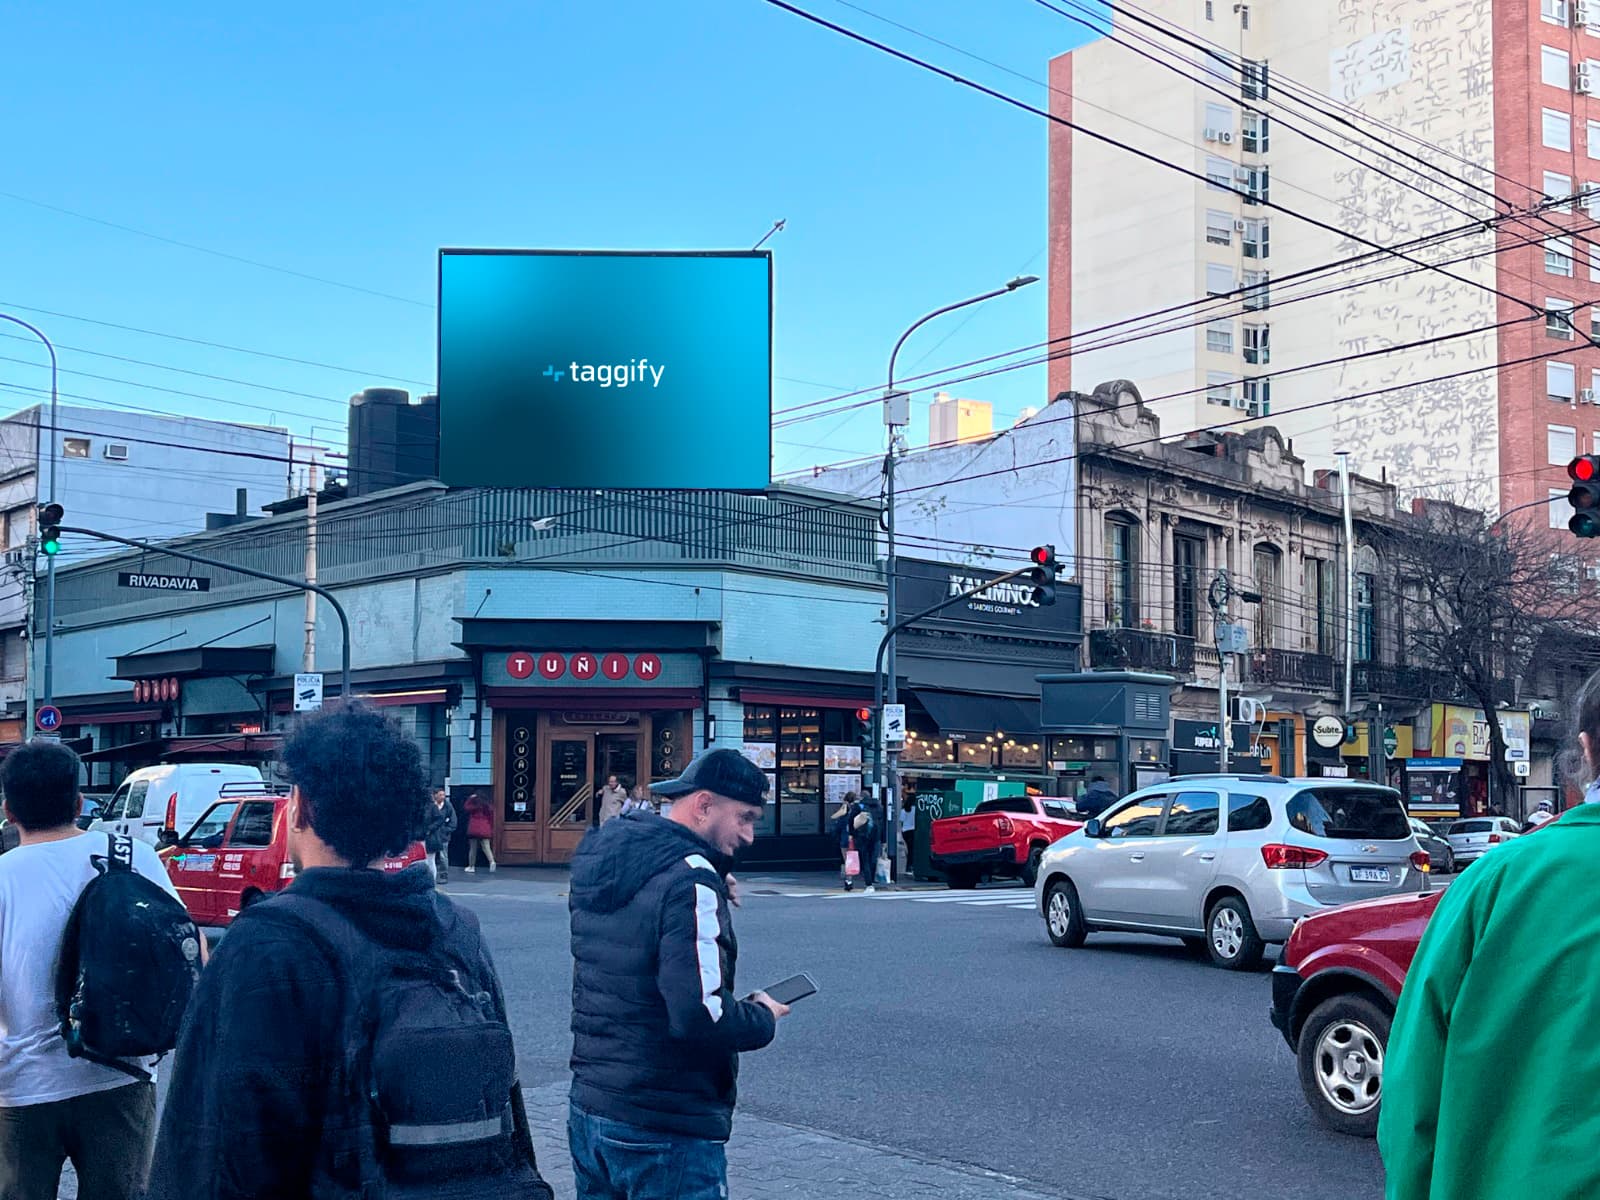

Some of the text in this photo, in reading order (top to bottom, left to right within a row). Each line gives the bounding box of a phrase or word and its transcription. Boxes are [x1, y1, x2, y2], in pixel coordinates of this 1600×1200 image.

[569, 358, 665, 388] taggify
[128, 575, 199, 590] RIVADAVIA
[515, 657, 653, 673] TUÑIN
[1316, 725, 1339, 734] Subte
